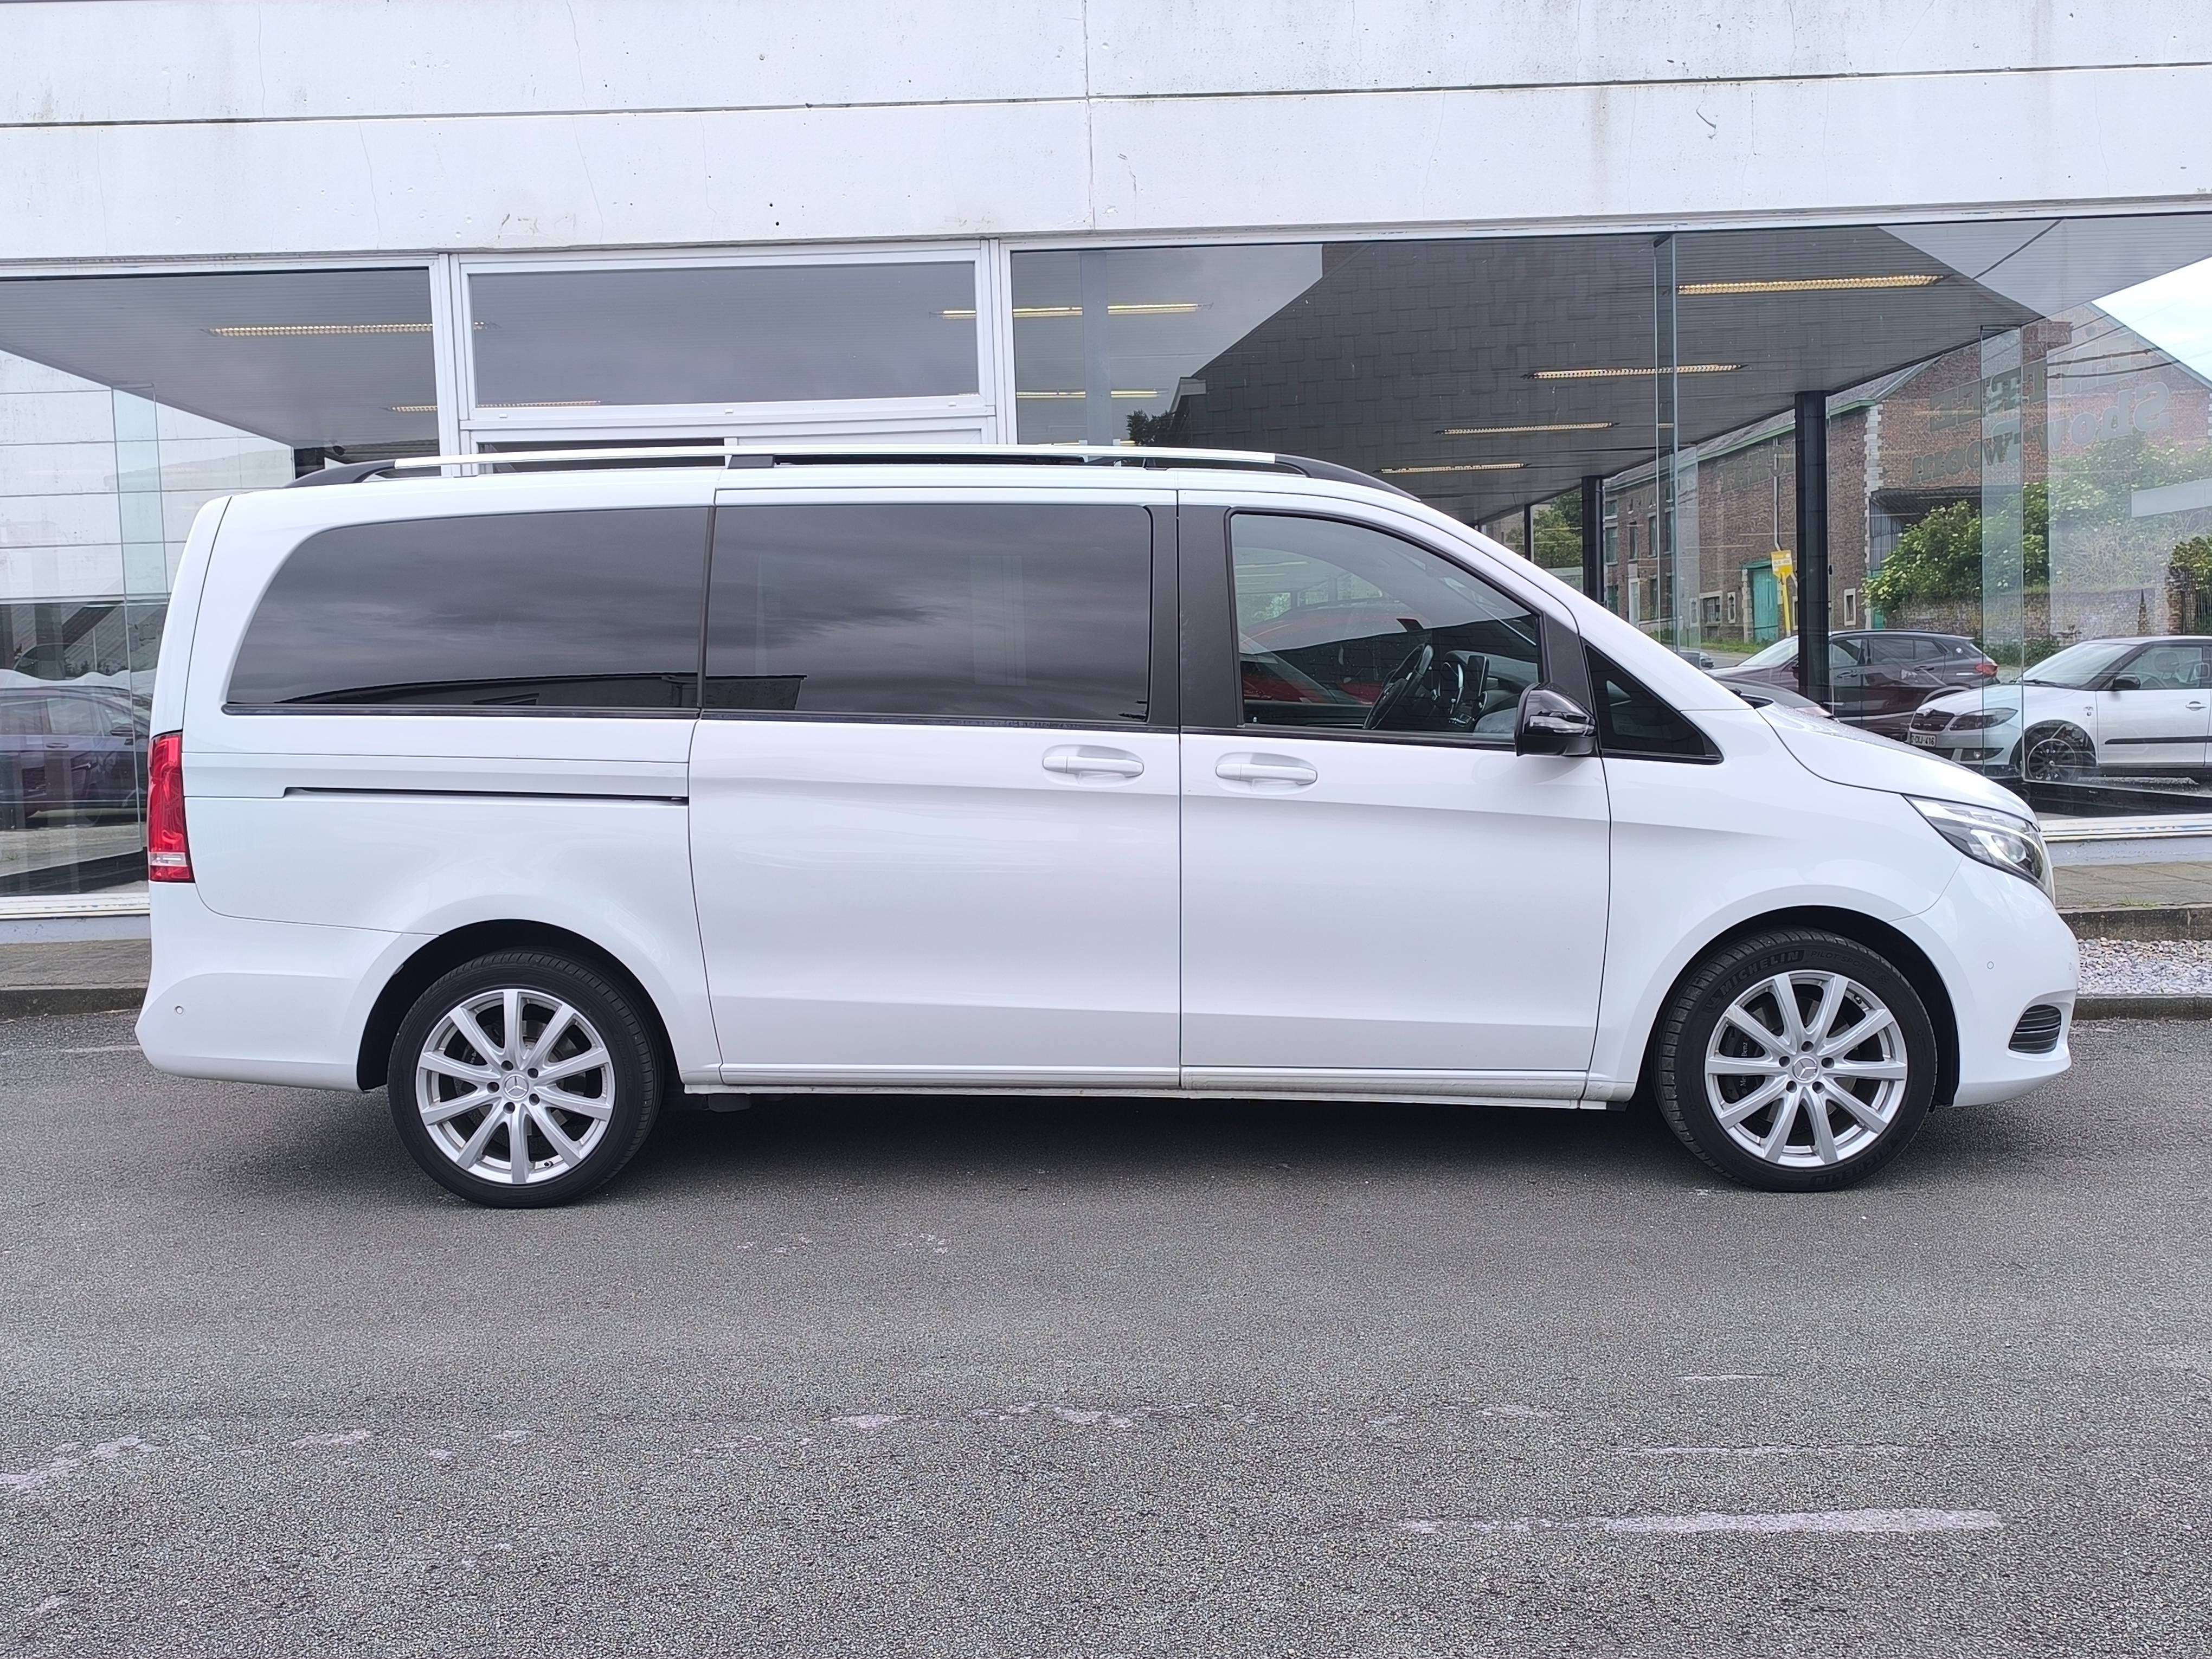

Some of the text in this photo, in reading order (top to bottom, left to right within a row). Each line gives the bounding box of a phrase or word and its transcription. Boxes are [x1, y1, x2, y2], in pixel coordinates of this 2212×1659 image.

[1719, 950, 1799, 995] MICHELIN
[1810, 950, 1870, 971] PILOT SPORT
